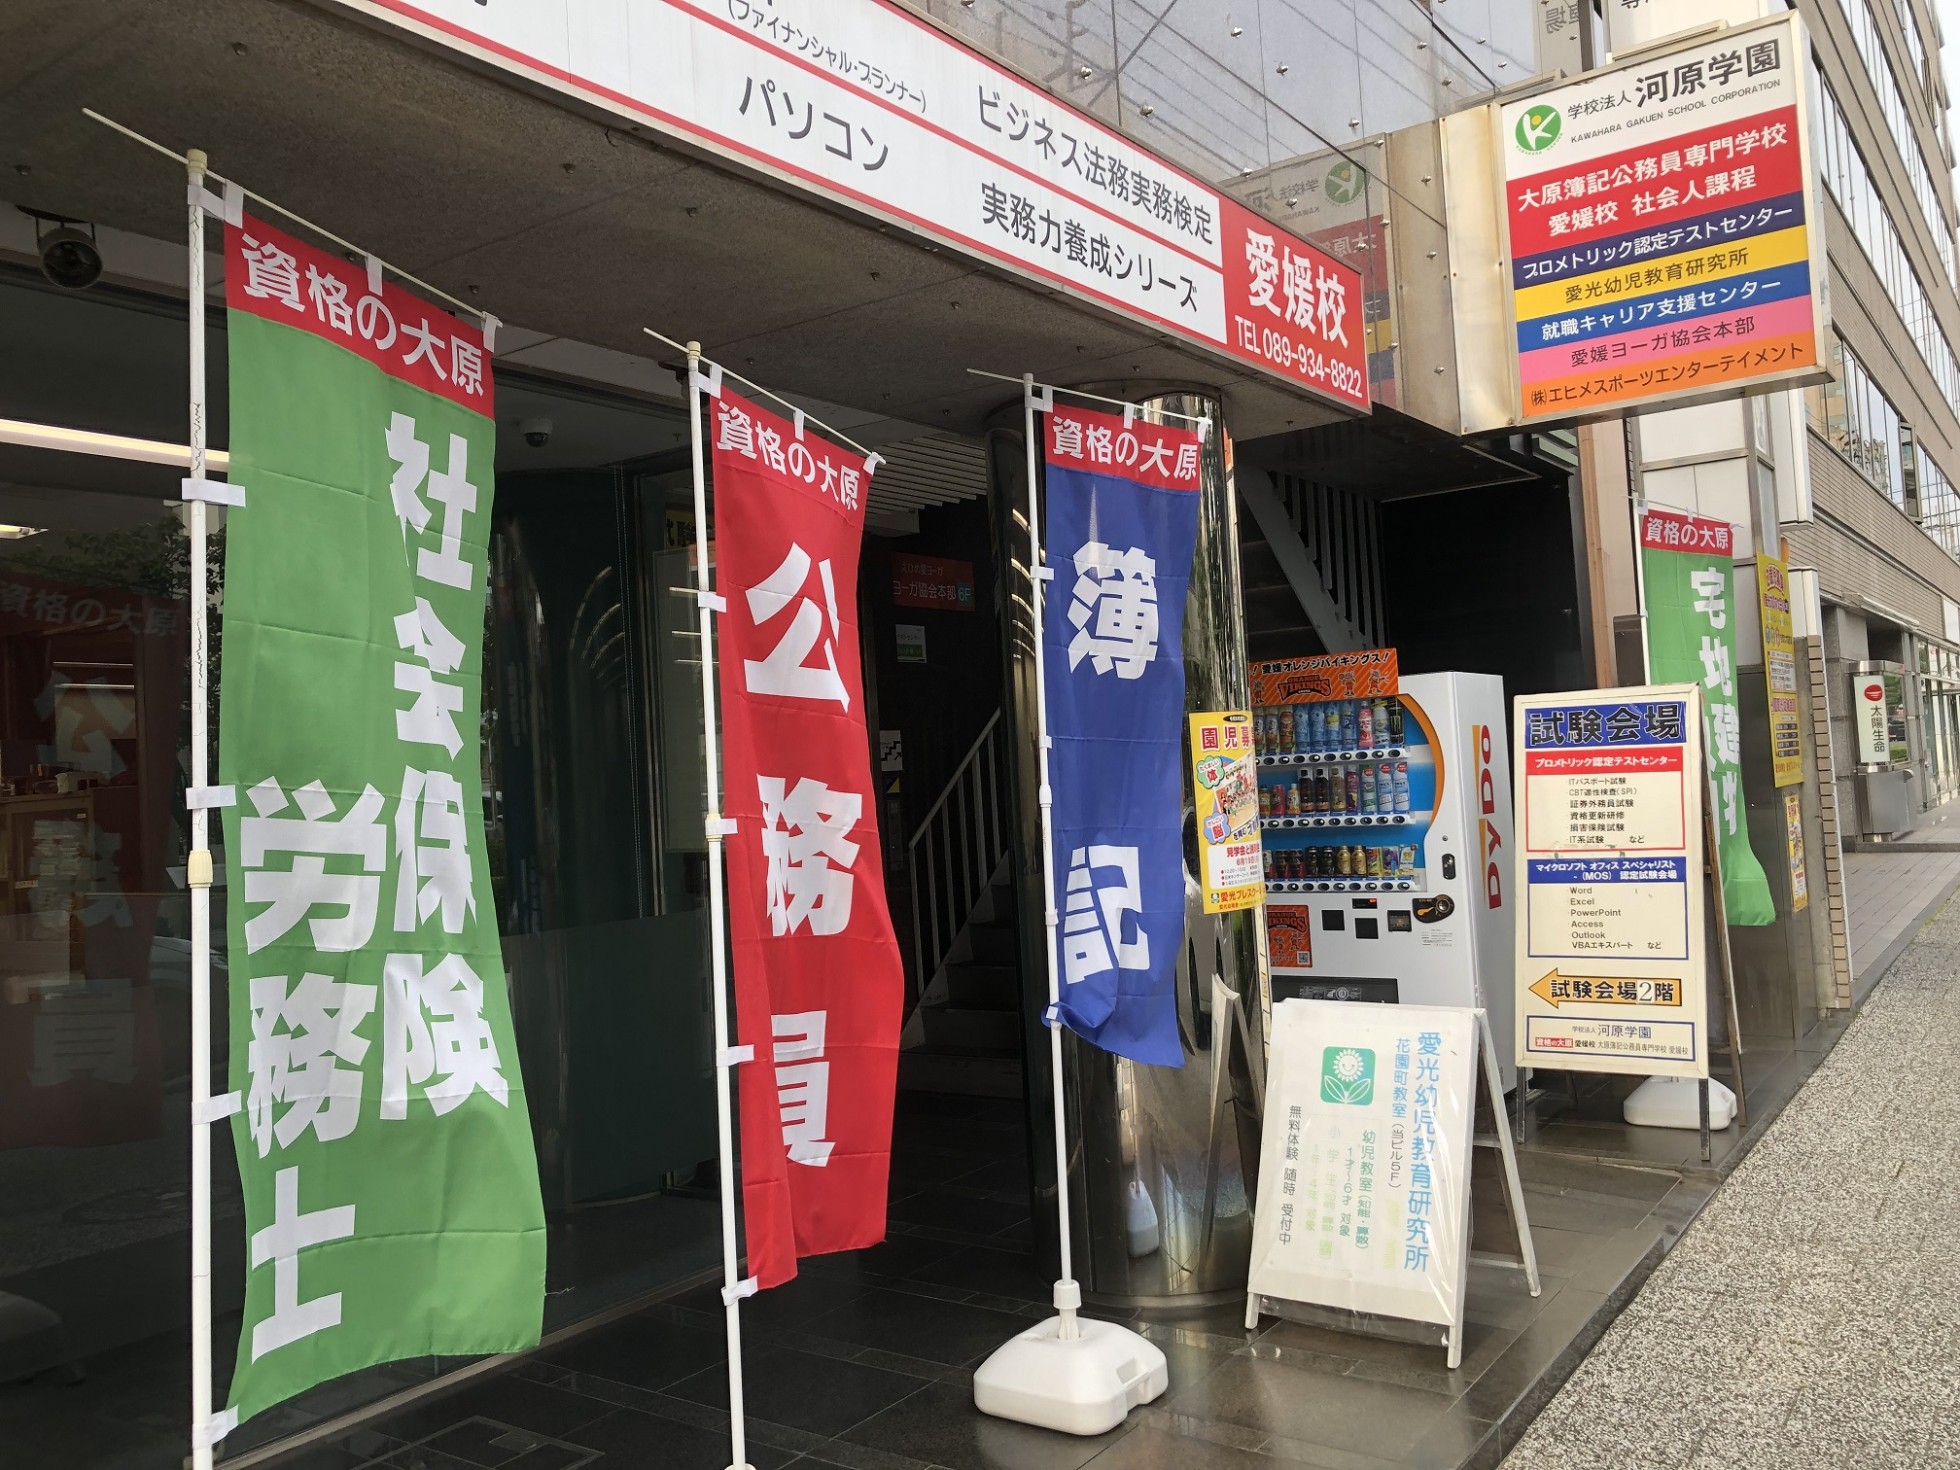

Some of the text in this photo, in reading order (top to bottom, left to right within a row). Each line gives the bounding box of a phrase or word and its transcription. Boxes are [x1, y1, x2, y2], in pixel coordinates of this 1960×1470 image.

[1567, 38, 1781, 121] 学校法人 河原学園
[739, 75, 888, 172] パソコン
[1570, 123, 1622, 144] KAWAHARA
[1626, 112, 1664, 129] GAKUEN
[1667, 100, 1707, 117] SCHOOL
[1710, 79, 1781, 105] CORPORATION
[978, 84, 1213, 245] ビジネス法務実務検定
[1518, 122, 1788, 213] 大原簿記公務員専門学校
[1548, 164, 1757, 238] 愛媛校 社会人課程
[981, 182, 1198, 312] 実務力養成シリーズ
[1523, 205, 1794, 279] プロメトリック認定テストセンター
[1245, 227, 1349, 349] 愛媛校
[1565, 247, 1750, 304] 愛光幼児教育研究所
[240, 233, 485, 397] 資格の大原
[1541, 279, 1781, 340] 就職キャリア支援センター
[1234, 314, 1363, 399] TEL 089-934-8822
[1570, 315, 1756, 368] 愛媛ヨーガ協会本部
[716, 400, 860, 512] 資格の大原
[1053, 416, 1198, 481] 資格の大原
[1646, 517, 1729, 549] 資格の大原
[1530, 704, 1680, 746] 試験会場
[1870, 705, 1886, 753] 太陽生命
[1063, 541, 1160, 984] 簿記
[1535, 756, 1678, 769] プロメトリック認定テストセンター
[1568, 777, 1627, 786] ITパスポート試験
[1570, 799, 1634, 808] 証券外務員試験
[1570, 811, 1625, 820] 資格更新研修
[1570, 823, 1625, 832] 損害保険試験
[744, 541, 862, 1168] 公務員
[1569, 835, 1645, 844] IT系試験 など
[1535, 860, 1676, 872] マイクロソフト オフィス スペシャリスト
[1569, 886, 1593, 895] Word
[1582, 870, 1678, 880] (MOS) 認定試験会場
[1570, 898, 1595, 906] Excel
[1570, 908, 1622, 917] PowerPoint
[1571, 920, 1604, 928] Access
[1571, 931, 1606, 939] Outlook
[1572, 941, 1663, 950] VBAエキスパート など
[1551, 979, 1674, 1002] 試験会場2階
[1536, 1038, 1573, 1048] 資格の大原
[1598, 1024, 1652, 1039] 河原学園
[239, 775, 387, 1365] 労務士
[1278, 1104, 1303, 1246] 無料体験 随時 受付中
[1403, 1031, 1442, 1274] 愛光幼児教育研究所
[1339, 1212, 1351, 1237] 対象
